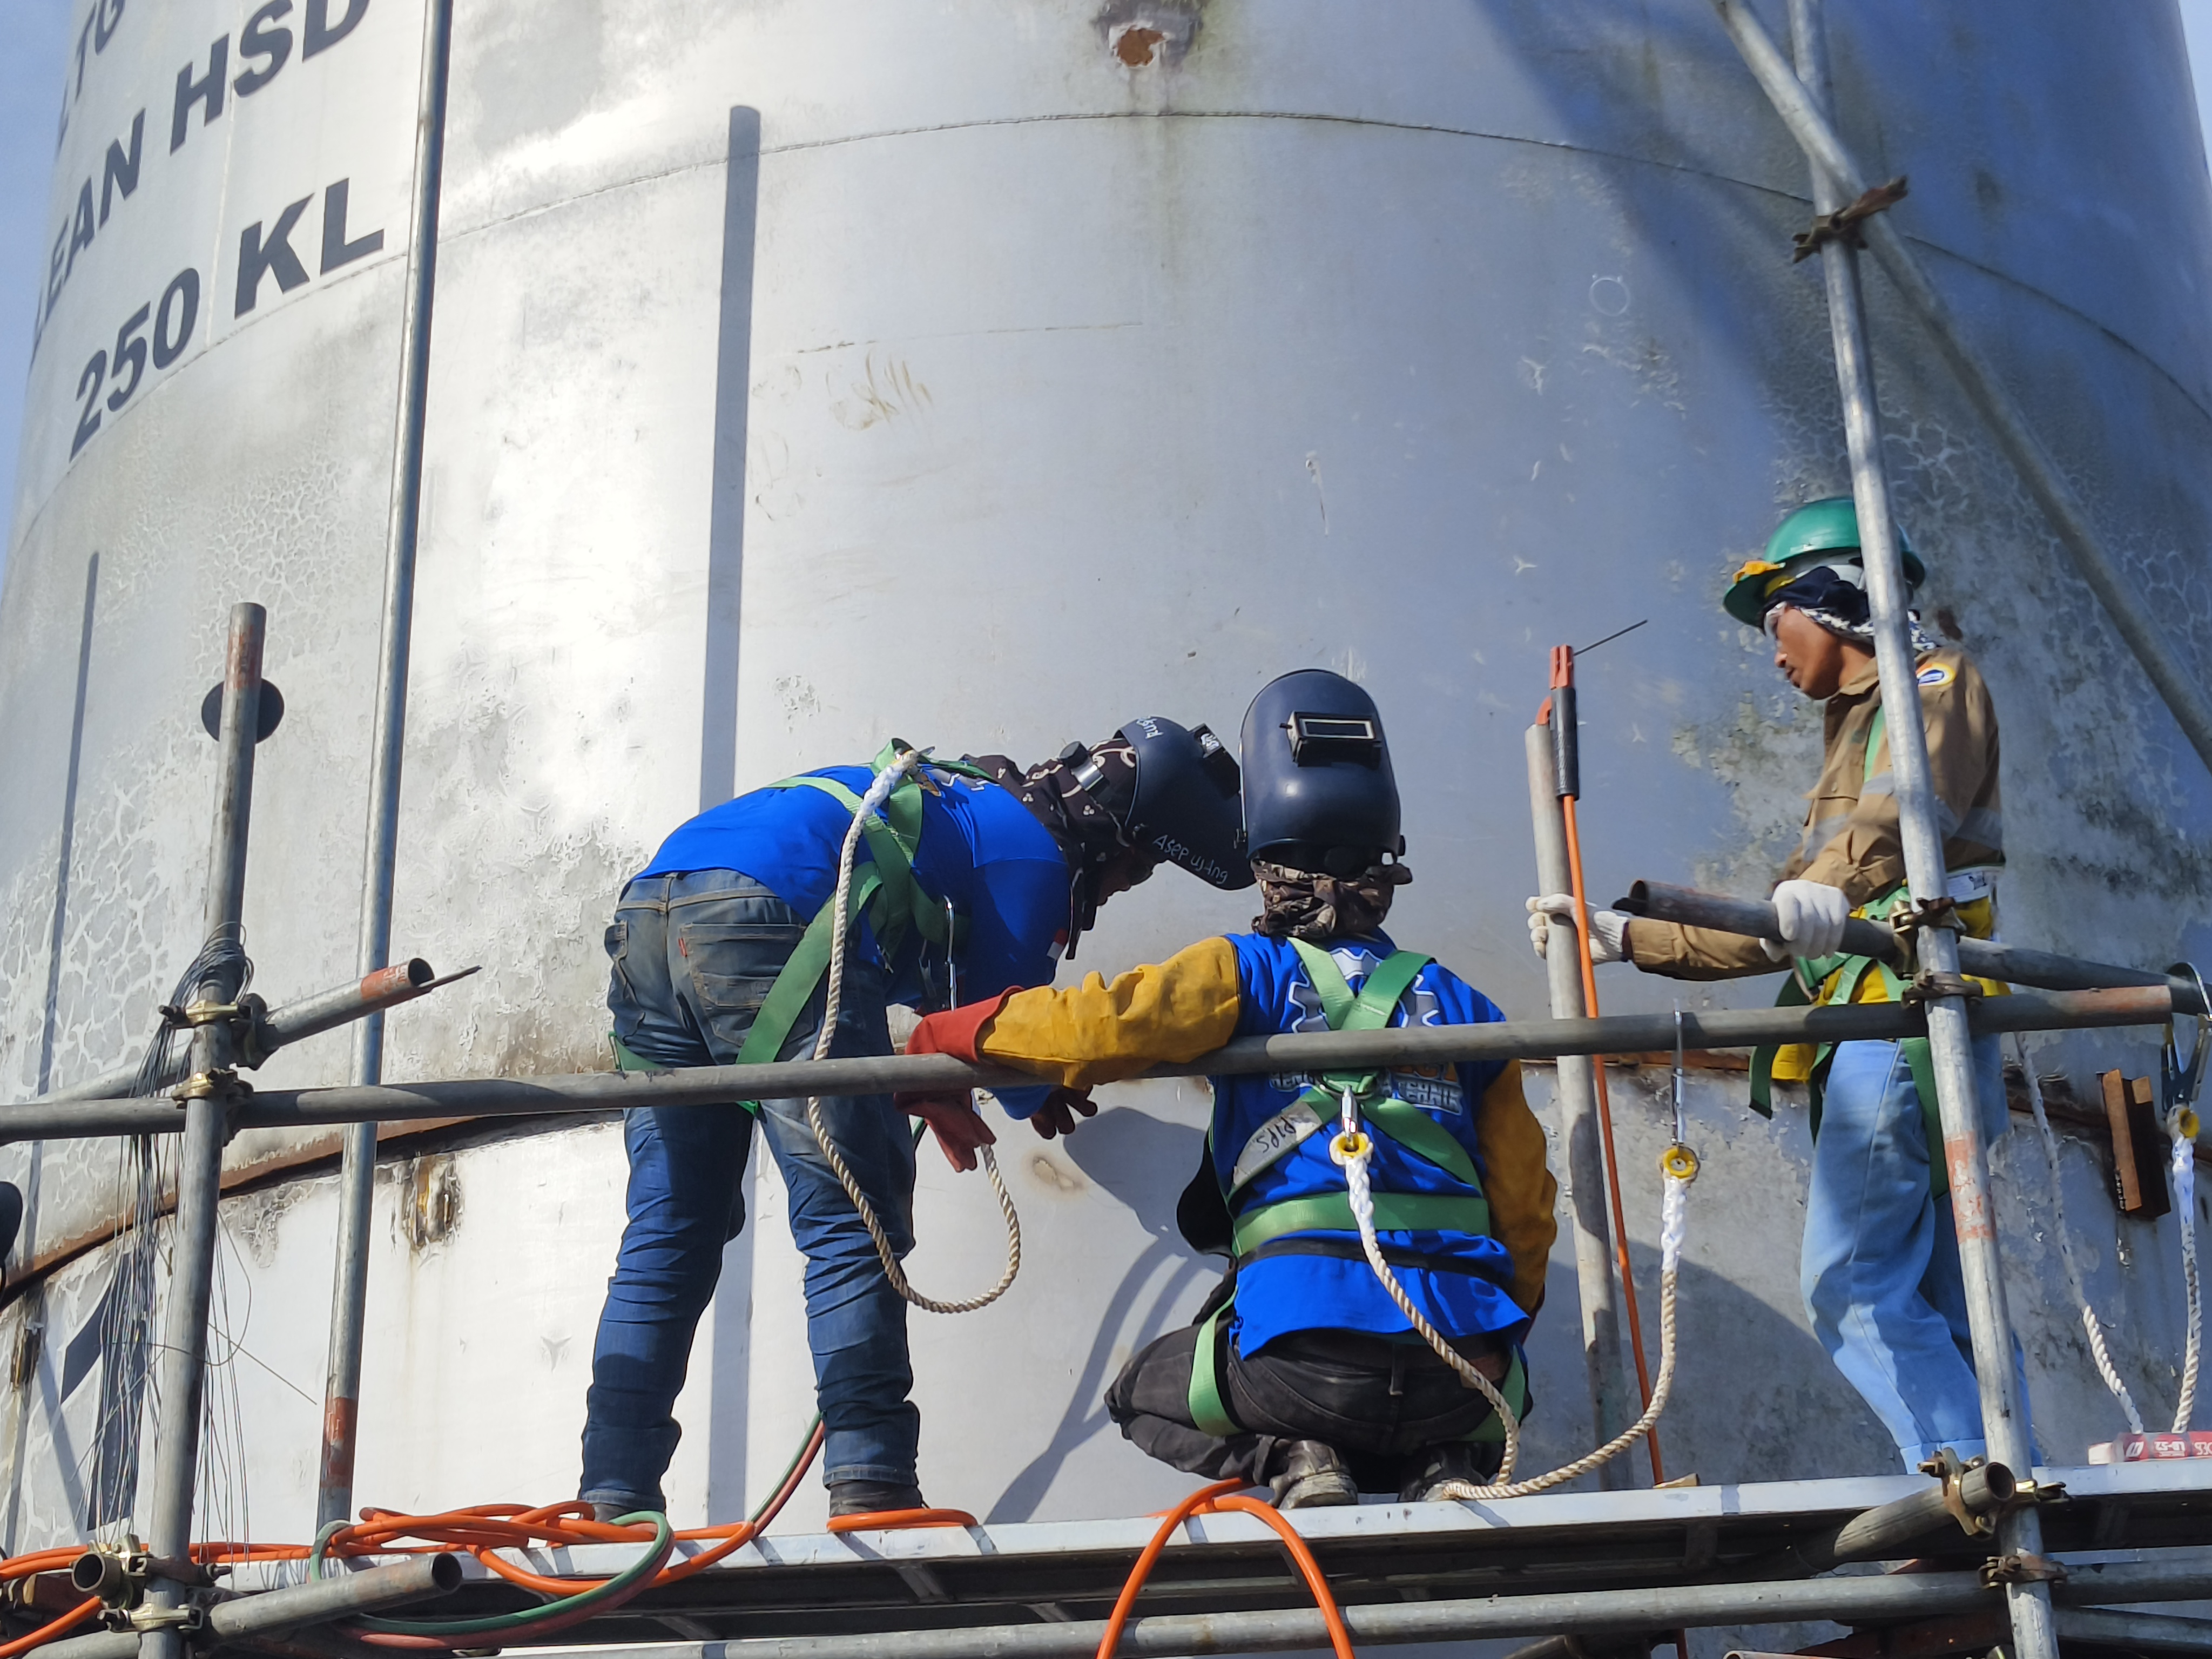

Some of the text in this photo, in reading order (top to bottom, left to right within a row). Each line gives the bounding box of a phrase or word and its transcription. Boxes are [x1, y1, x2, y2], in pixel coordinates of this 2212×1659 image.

[170, 0, 370, 157] HSD
[70, 178, 385, 463] 250 KL
[1152, 834, 1189, 861] Asep
